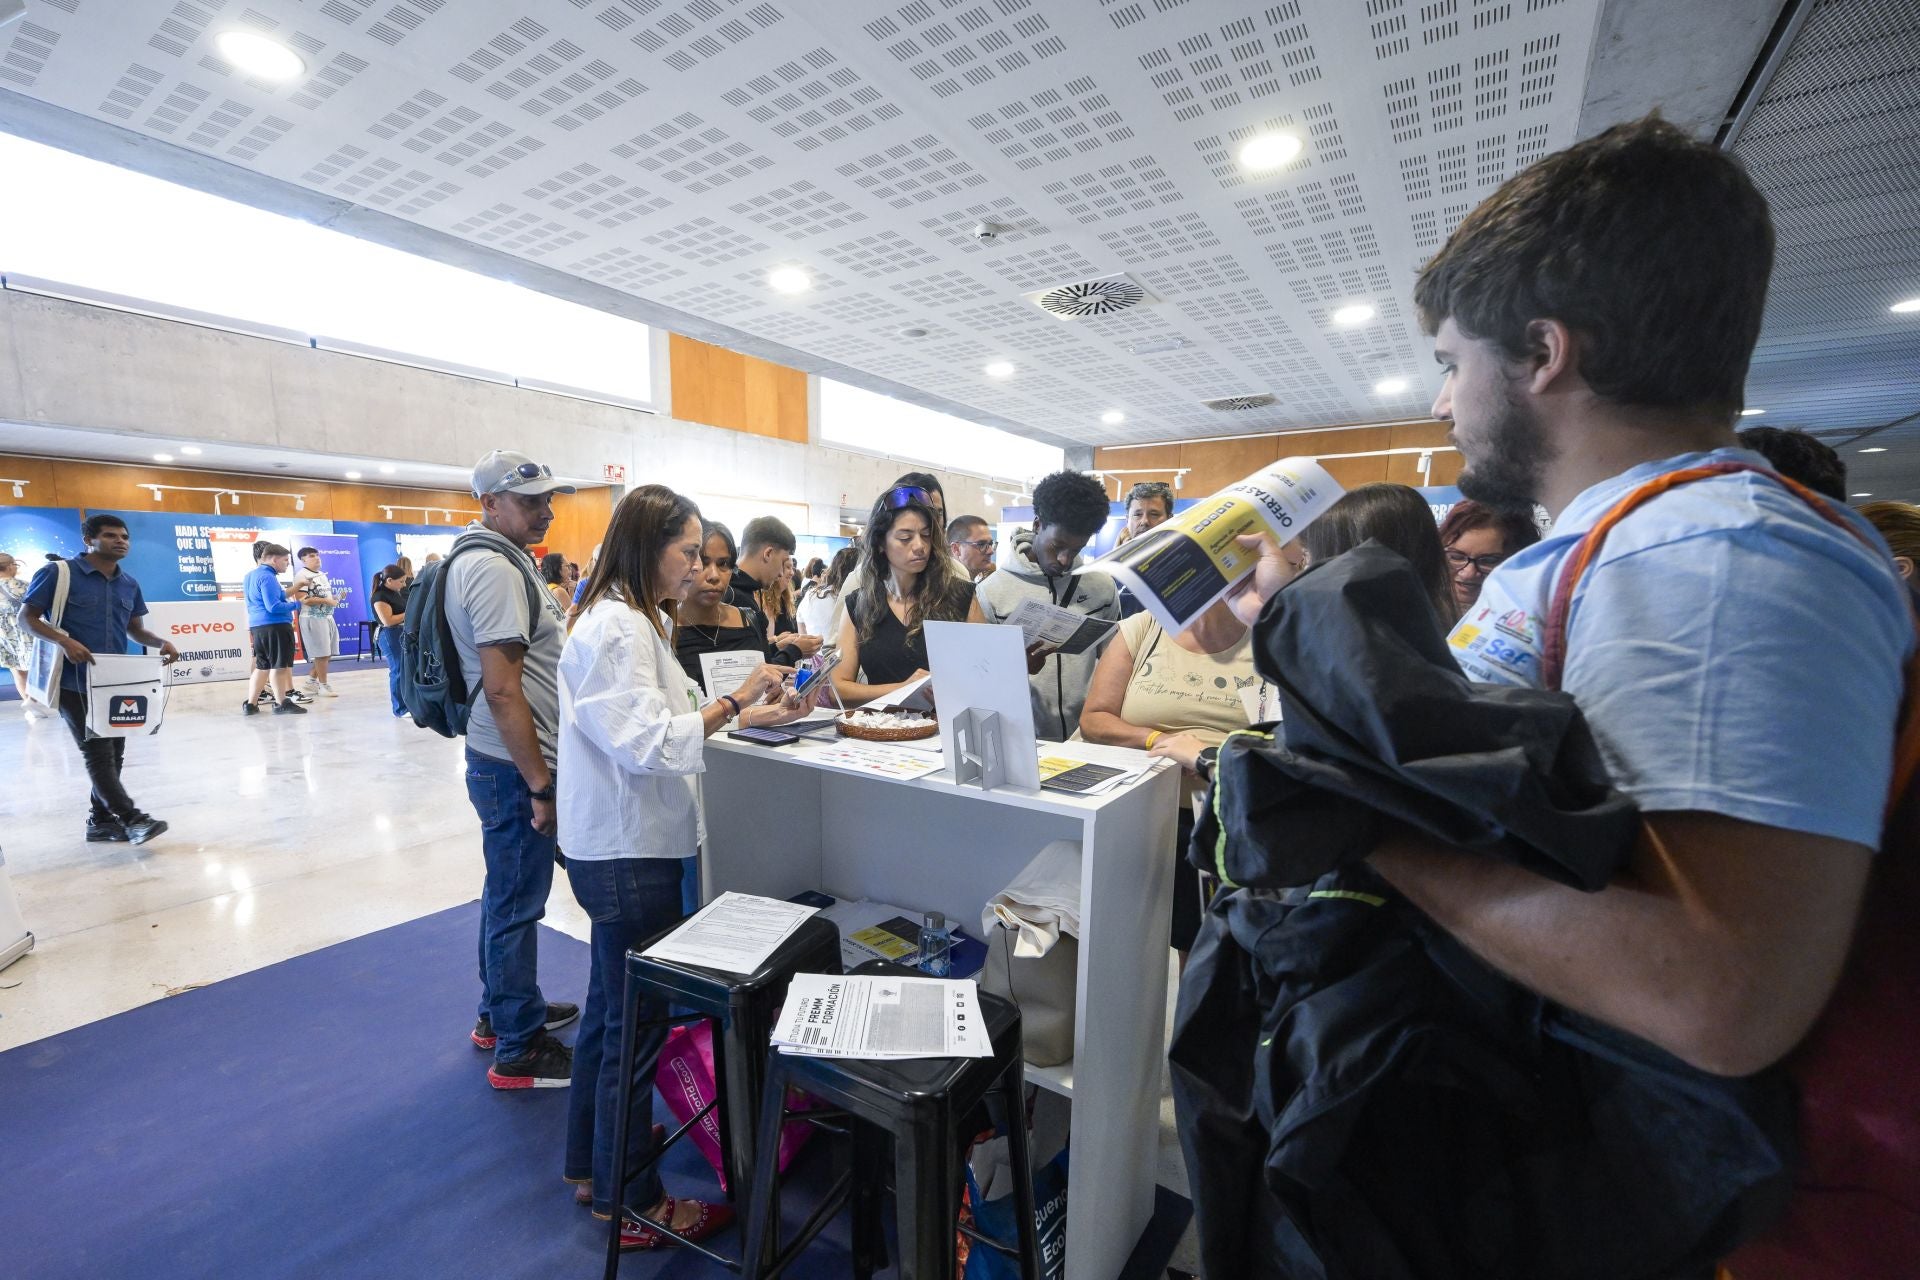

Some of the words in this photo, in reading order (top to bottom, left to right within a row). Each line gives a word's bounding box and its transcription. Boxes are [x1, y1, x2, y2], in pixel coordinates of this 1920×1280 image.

[1246, 486, 1293, 528] OFERTAS
[175, 525, 198, 537] NADA
[200, 526, 210, 537] SE
[177, 538, 194, 550] QUE
[195, 538, 207, 549] UN
[180, 563, 202, 573] Empleo
[194, 583, 217, 592] Edición
[171, 622, 235, 635] serveo
[178, 650, 213, 662] NERANDO
[214, 648, 242, 659] FUTURO
[1485, 638, 1534, 665] Sef
[173, 668, 192, 677] Sef
[1153, 683, 1168, 695] the
[1170, 691, 1193, 701] magic
[808, 998, 824, 1024] FREMM
[821, 984, 840, 1025] FORMACIÓN
